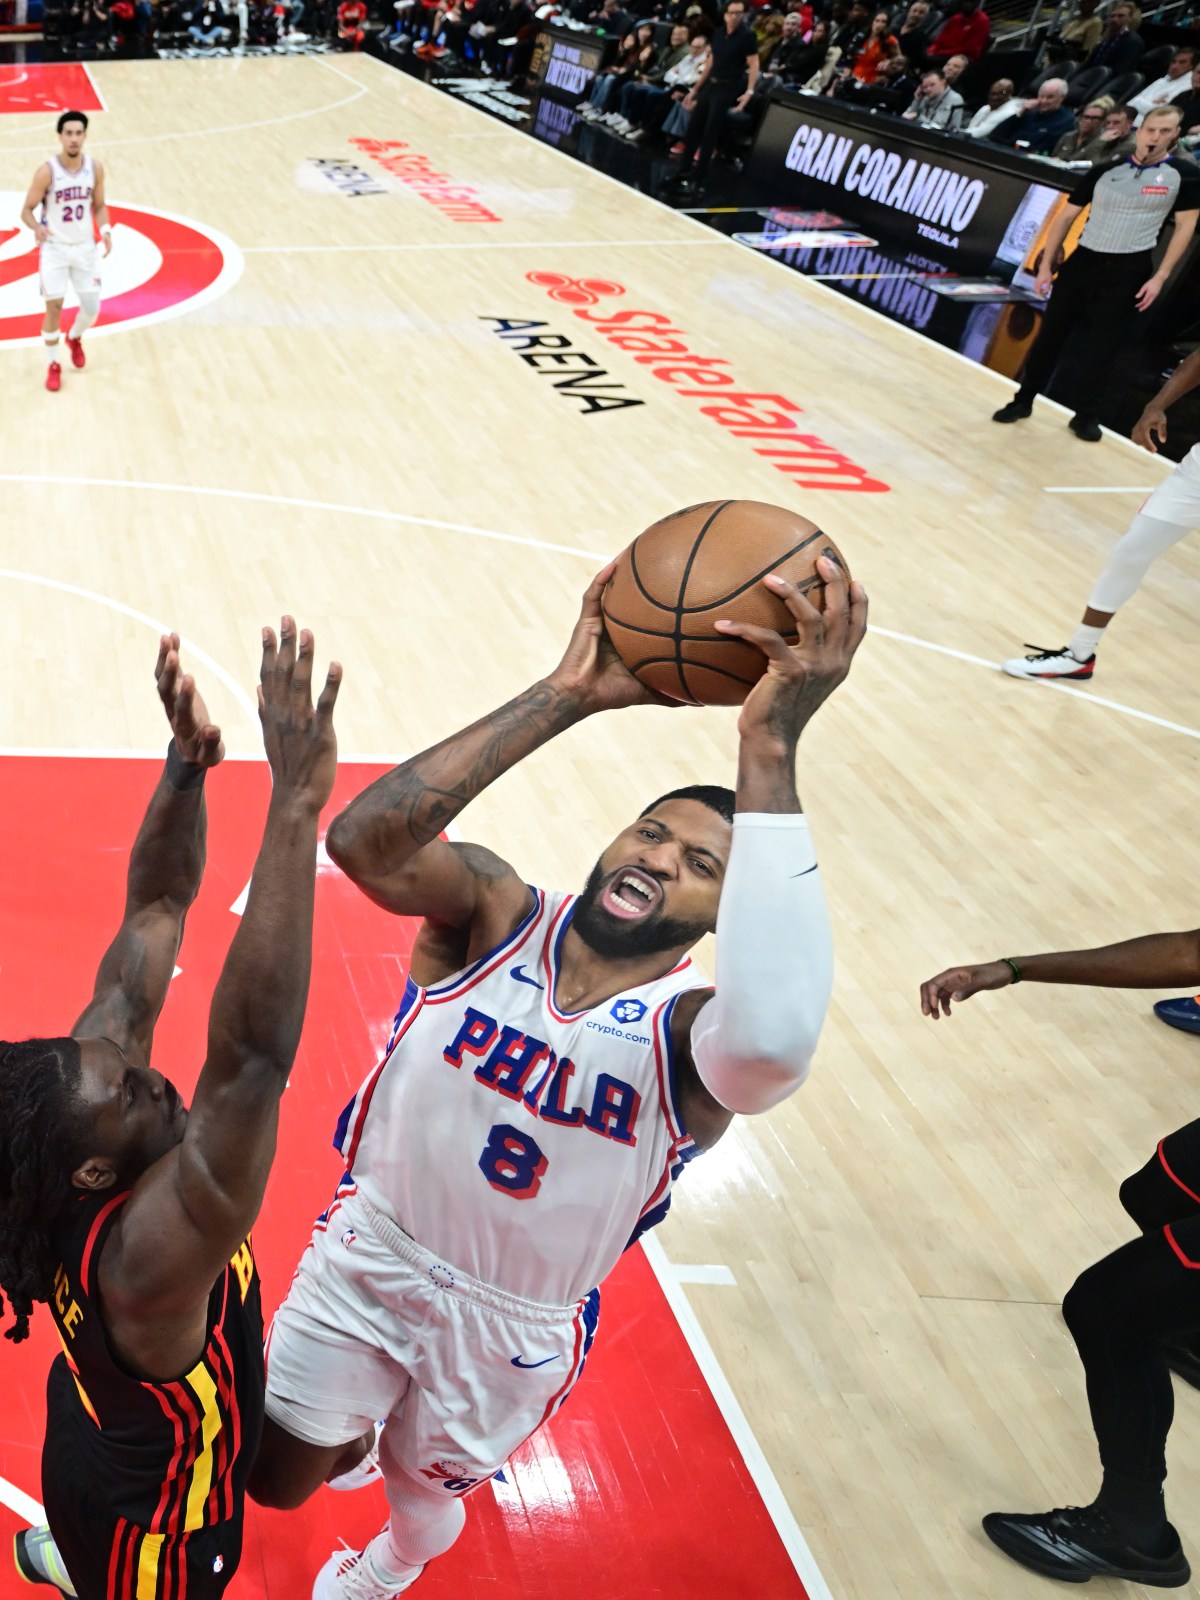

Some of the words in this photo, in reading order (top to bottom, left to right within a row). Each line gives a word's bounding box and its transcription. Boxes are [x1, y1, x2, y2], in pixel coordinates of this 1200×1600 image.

[62, 205, 85, 222] 20
[785, 124, 853, 185] GRAN
[843, 144, 987, 232] CORAMINO
[917, 223, 960, 249] TEQUILA
[478, 316, 646, 415] ARENA
[585, 1020, 652, 1046] crypto.com
[443, 1006, 643, 1148] PHILA
[478, 1123, 549, 1200] 8
